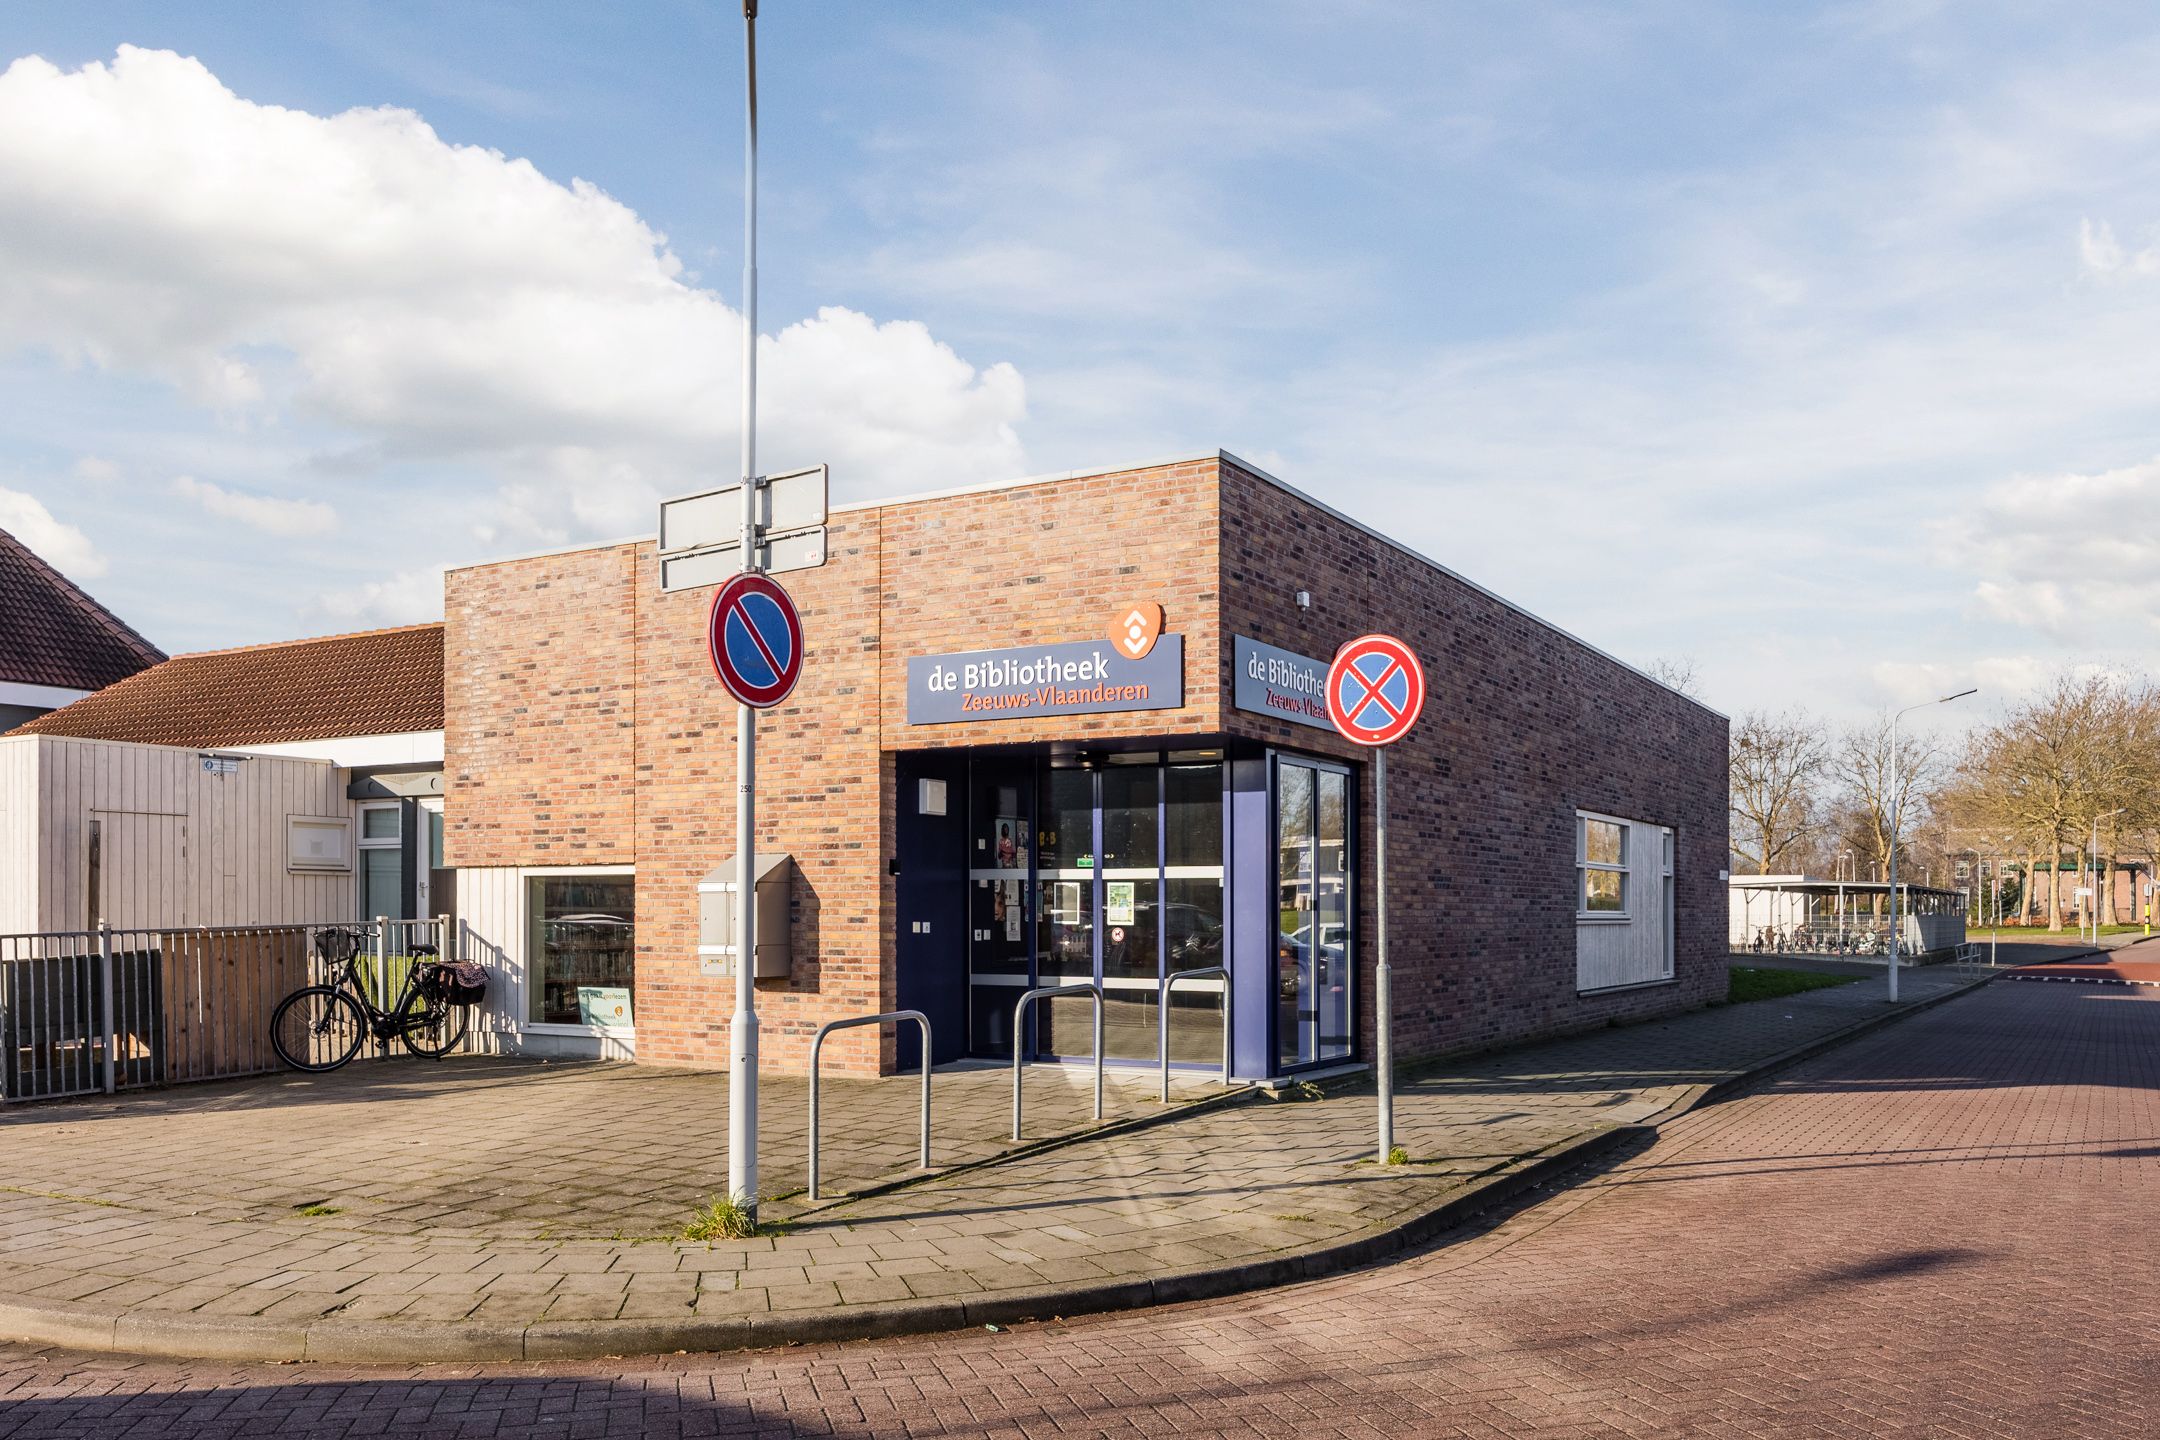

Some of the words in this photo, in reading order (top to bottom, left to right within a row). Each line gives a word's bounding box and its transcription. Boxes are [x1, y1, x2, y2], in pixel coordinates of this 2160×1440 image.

[928, 665, 958, 692] de
[964, 652, 1109, 689] Bibliotheek
[1248, 652, 1265, 681] de
[1268, 658, 1326, 697] Bibliothe
[961, 682, 1149, 712] Zeeuws-Vlaanderen
[1266, 687, 1331, 721] Zeeuws-Vlaan
